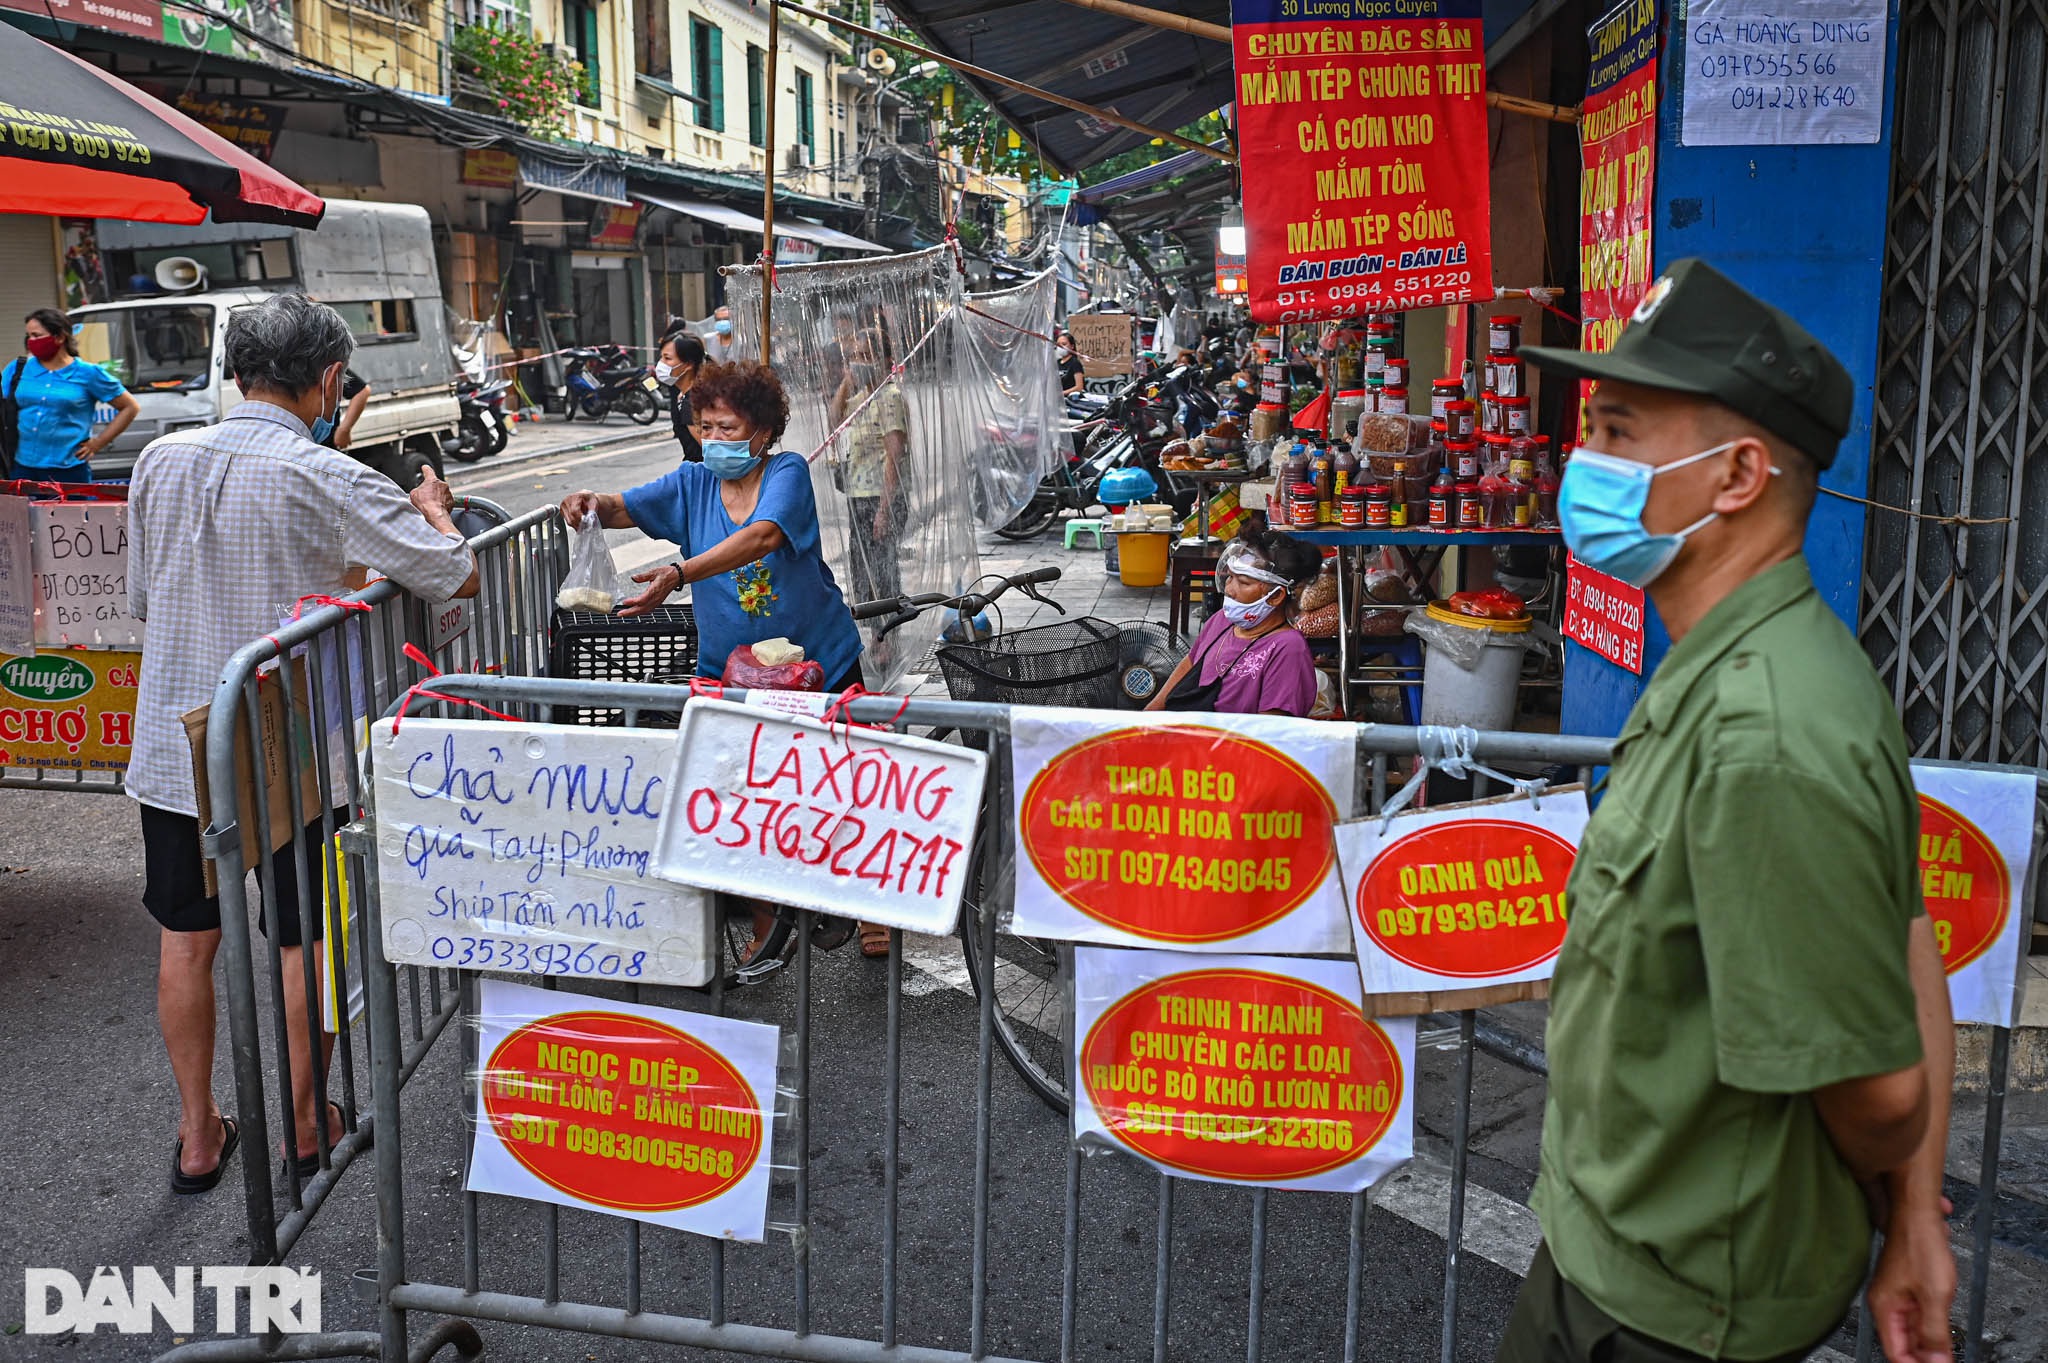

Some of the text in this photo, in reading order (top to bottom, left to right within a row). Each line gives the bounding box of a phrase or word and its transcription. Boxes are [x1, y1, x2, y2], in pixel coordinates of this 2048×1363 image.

[1281, 0, 1298, 16] 30
[1303, 0, 1350, 18] Lương
[1355, 0, 1391, 17] Ngọc
[1694, 14, 1870, 45] GÀ HOÀNG DUNG
[1248, 22, 1472, 56] CHUYÊN ĐẶC SẢN
[1241, 60, 1482, 106] MẮM TÉP CHƯNG THỊT
[1702, 53, 1836, 78] 0978555566
[1732, 86, 1855, 110] 0912287640
[69, 132, 110, 159] 809
[111, 138, 151, 164] 929
[74, 119, 138, 141] LINH
[1298, 114, 1434, 152] CÁ CƠM KHO
[1316, 156, 1425, 201] MẮM TÔM
[1287, 201, 1455, 254] MẮM TÉP SỐNG
[1279, 260, 1325, 284] BÁN
[1327, 253, 1384, 280] BUÔN
[1399, 247, 1442, 270] BÁN
[1446, 242, 1467, 264] LẺ
[1276, 271, 1471, 306] ĐT: 0984 551220
[1279, 306, 1321, 324] CH:
[1330, 304, 1356, 318] 34
[1364, 294, 1434, 315] HÀNG
[440, 604, 462, 634] STOP
[1583, 584, 1605, 614] 0984
[1606, 594, 1639, 632] 551220
[1580, 618, 1595, 643] 34
[6, 662, 139, 695] Huyền CÁ
[0, 704, 87, 754] CHỢ
[407, 733, 515, 806] Chả
[746, 722, 953, 821] LÁ XÔNG
[1106, 764, 1235, 802] THOA BÉO
[1050, 795, 1303, 841] CÁC LOẠI HOA TƯƠI
[1064, 847, 1291, 893] SĐT 0974349645
[1400, 845, 1543, 896] OANH QUẢ
[432, 937, 647, 977] 0353393608
[1157, 995, 1322, 1036] TRINH THANH
[537, 1041, 699, 1096] NGỌC DIỆP
[1130, 1030, 1350, 1079] CHUYÊN CÁC LOẠI
[1092, 1053, 1390, 1113] RUỐC BÒ KHÔ LƯƠN KHÔ
[531, 1076, 553, 1105] NI
[560, 1078, 613, 1116] LÔNG
[635, 1092, 692, 1129] BĂNG
[700, 1103, 750, 1140] DÍNH
[1125, 1101, 1353, 1152] SĐT 0936432366
[510, 1112, 734, 1179] SĐT 0983005568
